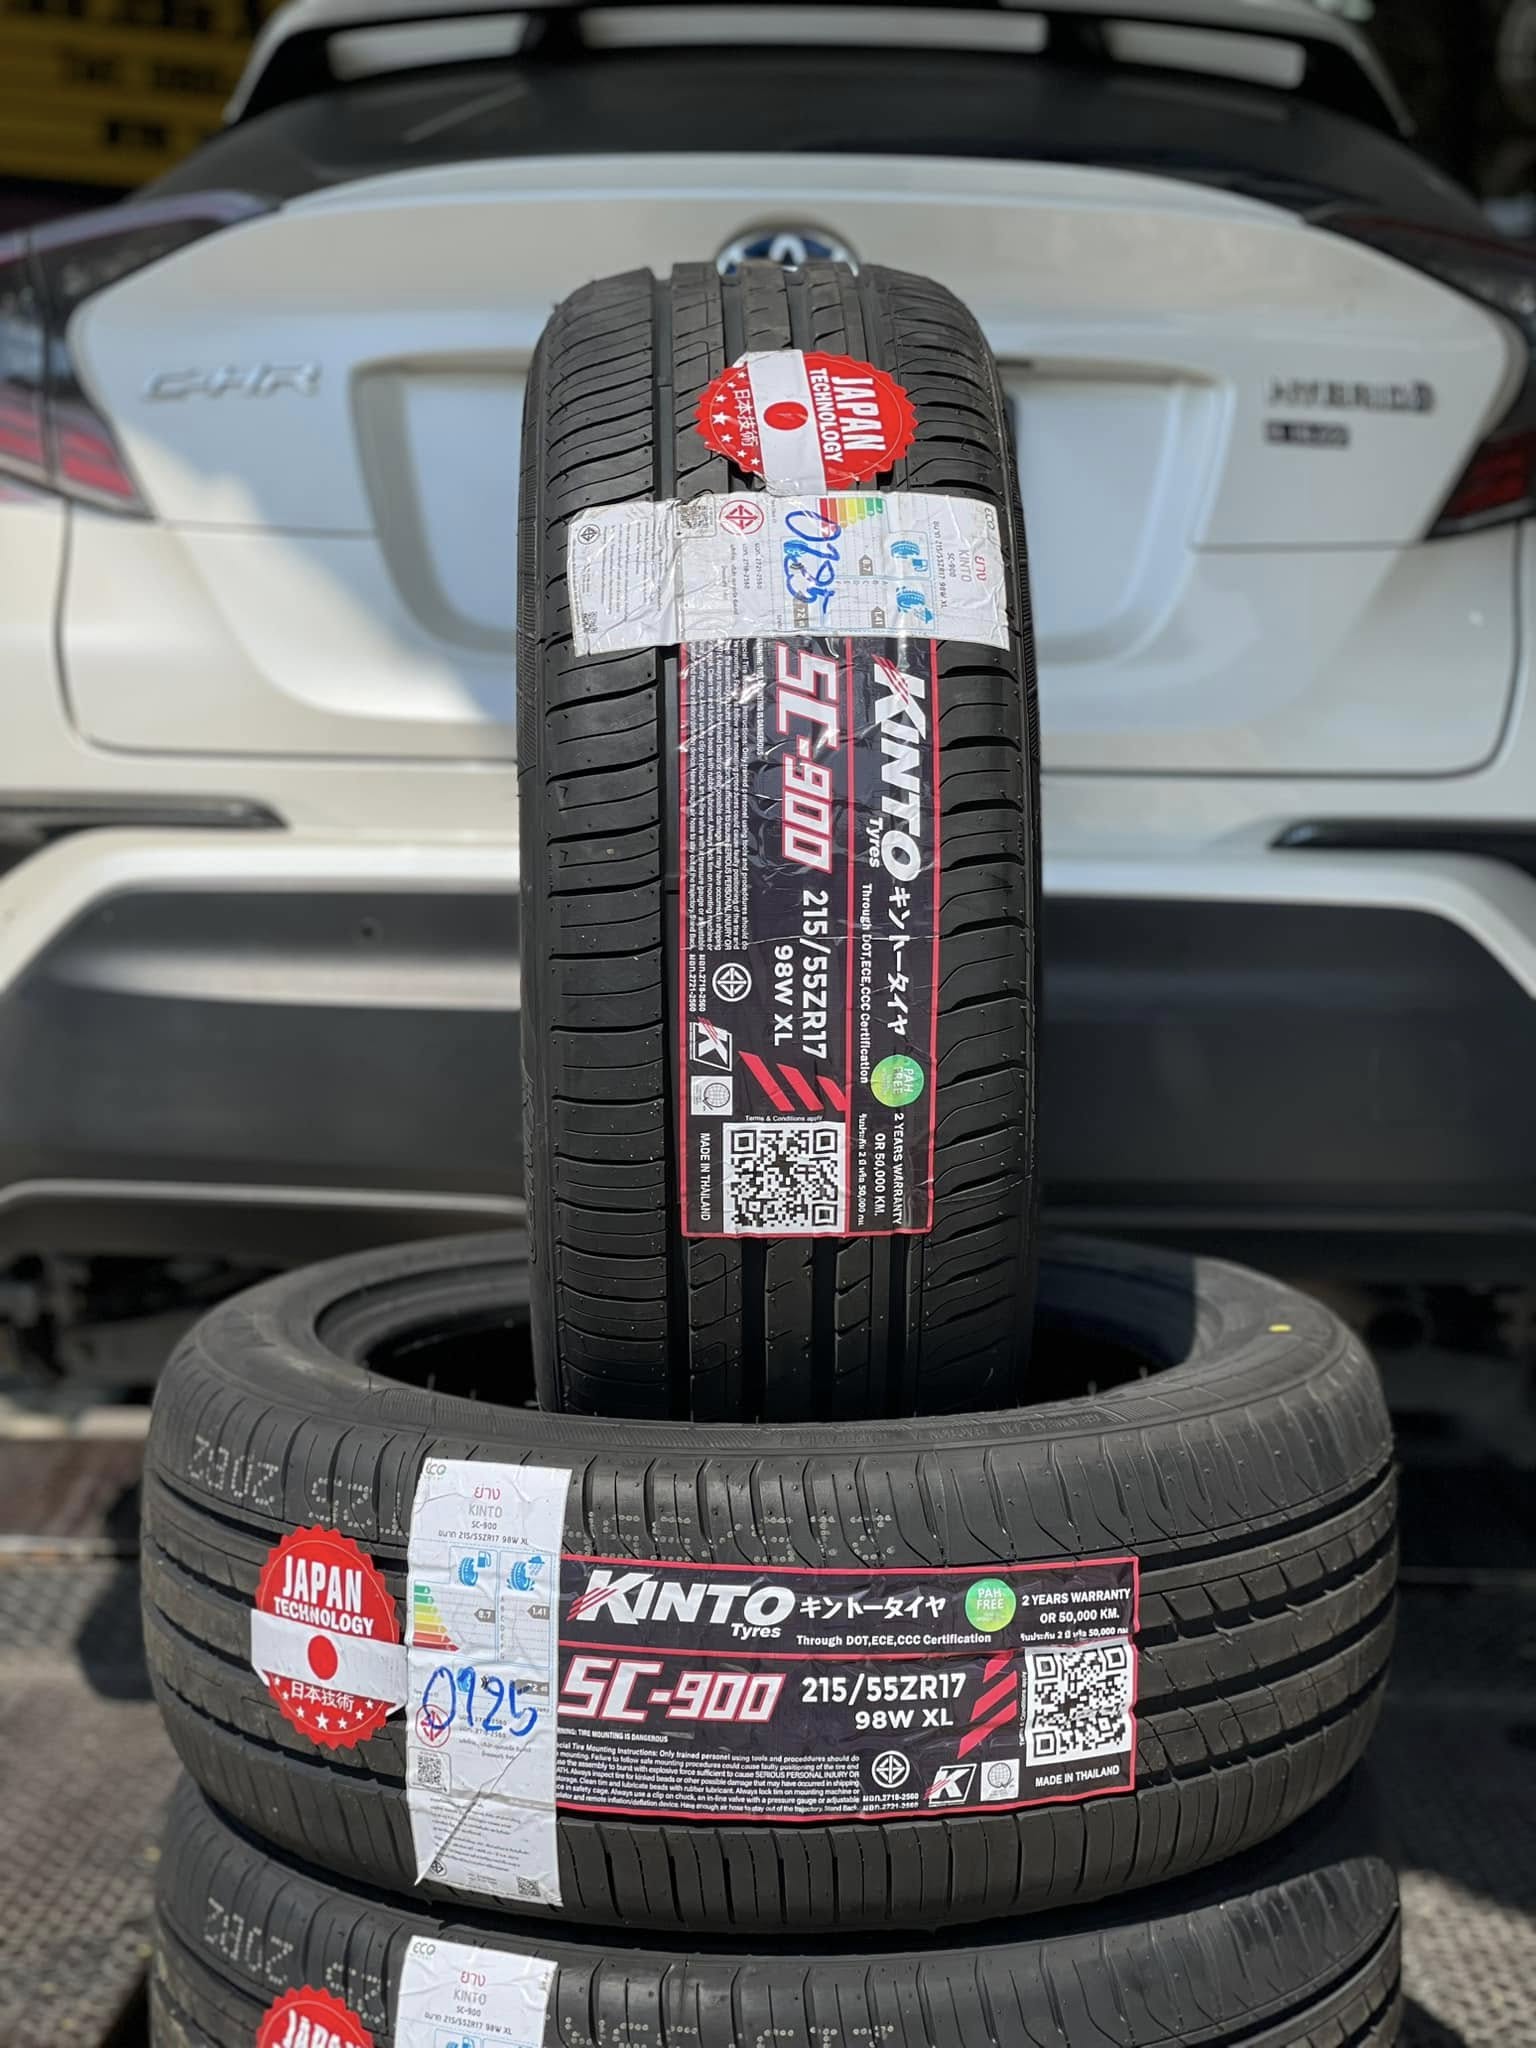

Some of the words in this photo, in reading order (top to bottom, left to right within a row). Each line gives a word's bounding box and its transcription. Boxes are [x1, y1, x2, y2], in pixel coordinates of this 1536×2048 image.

[734, 389, 758, 447] 日本技術
[809, 368, 843, 462] TECHNOLOGY
[831, 376, 886, 450] JAPAN
[947, 552, 956, 578] SC-900
[958, 550, 971, 582] KINTO
[975, 556, 986, 581] ยาง
[874, 611, 883, 625] 1.41
[741, 747, 749, 763] Only
[776, 641, 840, 874] SC-900
[741, 764, 749, 788] trained
[872, 655, 926, 882] KINTO
[740, 819, 748, 839] using
[865, 817, 883, 868] Tyres
[724, 844, 732, 874] SERIOUS
[741, 857, 749, 871] and
[724, 875, 732, 914] PERSONAL
[860, 883, 872, 930] Through
[724, 914, 732, 939] INJURY
[741, 916, 749, 940] should
[724, 939, 732, 951] OR
[741, 940, 749, 951] do
[859, 934, 872, 1011] DOT,ECE,CCC
[887, 886, 910, 1036] キントータイヤ
[773, 944, 793, 1006] 98W
[799, 889, 831, 1059] 215/55ZR17
[698, 1018, 728, 1065] K
[773, 1013, 793, 1046] XL
[859, 1012, 871, 1084] Certification
[892, 1066, 904, 1095] FREE
[903, 1068, 914, 1093] PAH
[894, 1112, 904, 1121] 2
[699, 1132, 711, 1162] MADE
[874, 1133, 885, 1150] OR
[892, 1123, 904, 1162] YEARS
[699, 1163, 711, 1174] IN
[873, 1152, 885, 1193] 50,000
[699, 1175, 711, 1221] THAILAND
[857, 1184, 866, 1213] 50,000
[874, 1195, 885, 1217] KM.
[892, 1165, 903, 1225] WARRANTY
[425, 1462, 447, 1476] ECO
[473, 1486, 501, 1501] ยาง
[468, 1504, 503, 1518] KINTO
[458, 1531, 499, 1541] 215/55ZR17
[471, 1520, 497, 1530] SC-900
[282, 1555, 362, 1614] JAPAN
[977, 1587, 1002, 1599] PAH
[1021, 1595, 1031, 1607] 2
[1031, 1592, 1069, 1606] YEARS
[1070, 1587, 1131, 1604] WARRANTY
[566, 1569, 796, 1626] KINTO
[800, 1595, 947, 1620] キントータイヤ
[976, 1598, 1005, 1610] FREE
[273, 1597, 375, 1636] TECHNOLOGY
[531, 1607, 547, 1617] 1.41
[1039, 1612, 1057, 1624] OR
[1058, 1609, 1098, 1624] 50,000
[1099, 1607, 1120, 1620] KM.
[731, 1623, 783, 1641] Tyres
[796, 1634, 843, 1648] Through
[846, 1635, 921, 1648] DOT,ECE,CCC
[923, 1633, 992, 1646] Certification
[1057, 1631, 1064, 1639] 2
[1088, 1627, 1116, 1638] 50,000
[290, 1681, 354, 1713] 日本技術
[422, 1665, 538, 1737] 0125
[557, 1654, 787, 1723] SC-900
[801, 1672, 967, 1706] 215/55ZR17
[855, 1709, 915, 1730] 98W
[921, 1707, 954, 1728] XL
[578, 1728, 591, 1737] TIRE
[591, 1730, 624, 1740] MOUNTING
[631, 1733, 668, 1743] DANGEROUS
[572, 1742, 585, 1751] Tire
[585, 1743, 617, 1755] Mounting
[617, 1746, 658, 1757] Instructions:
[659, 1749, 675, 1759] Only
[676, 1750, 700, 1759] trained
[701, 1753, 731, 1762] personel
[731, 1755, 750, 1763] using
[751, 1754, 768, 1762] tools
[769, 1754, 783, 1762] and
[826, 1754, 850, 1762] should
[850, 1754, 860, 1762] do
[620, 1756, 639, 1764] follow
[654, 1759, 684, 1768] mounting
[779, 1764, 815, 1772] positioning
[755, 1770, 786, 1779] SERIOUS
[786, 1770, 824, 1779] PERSONAL
[848, 1770, 860, 1778] OR
[924, 1768, 971, 1800] K
[1035, 1774, 1063, 1788] MADE
[1064, 1773, 1074, 1783] IN
[1075, 1764, 1120, 1781] THAILAND
[412, 1942, 437, 1957] ECO
[460, 1970, 486, 1987] ยาง
[452, 1989, 487, 2005] KINTO
[456, 2005, 482, 2018] SC-900
[281, 2009, 361, 2048] JAP
